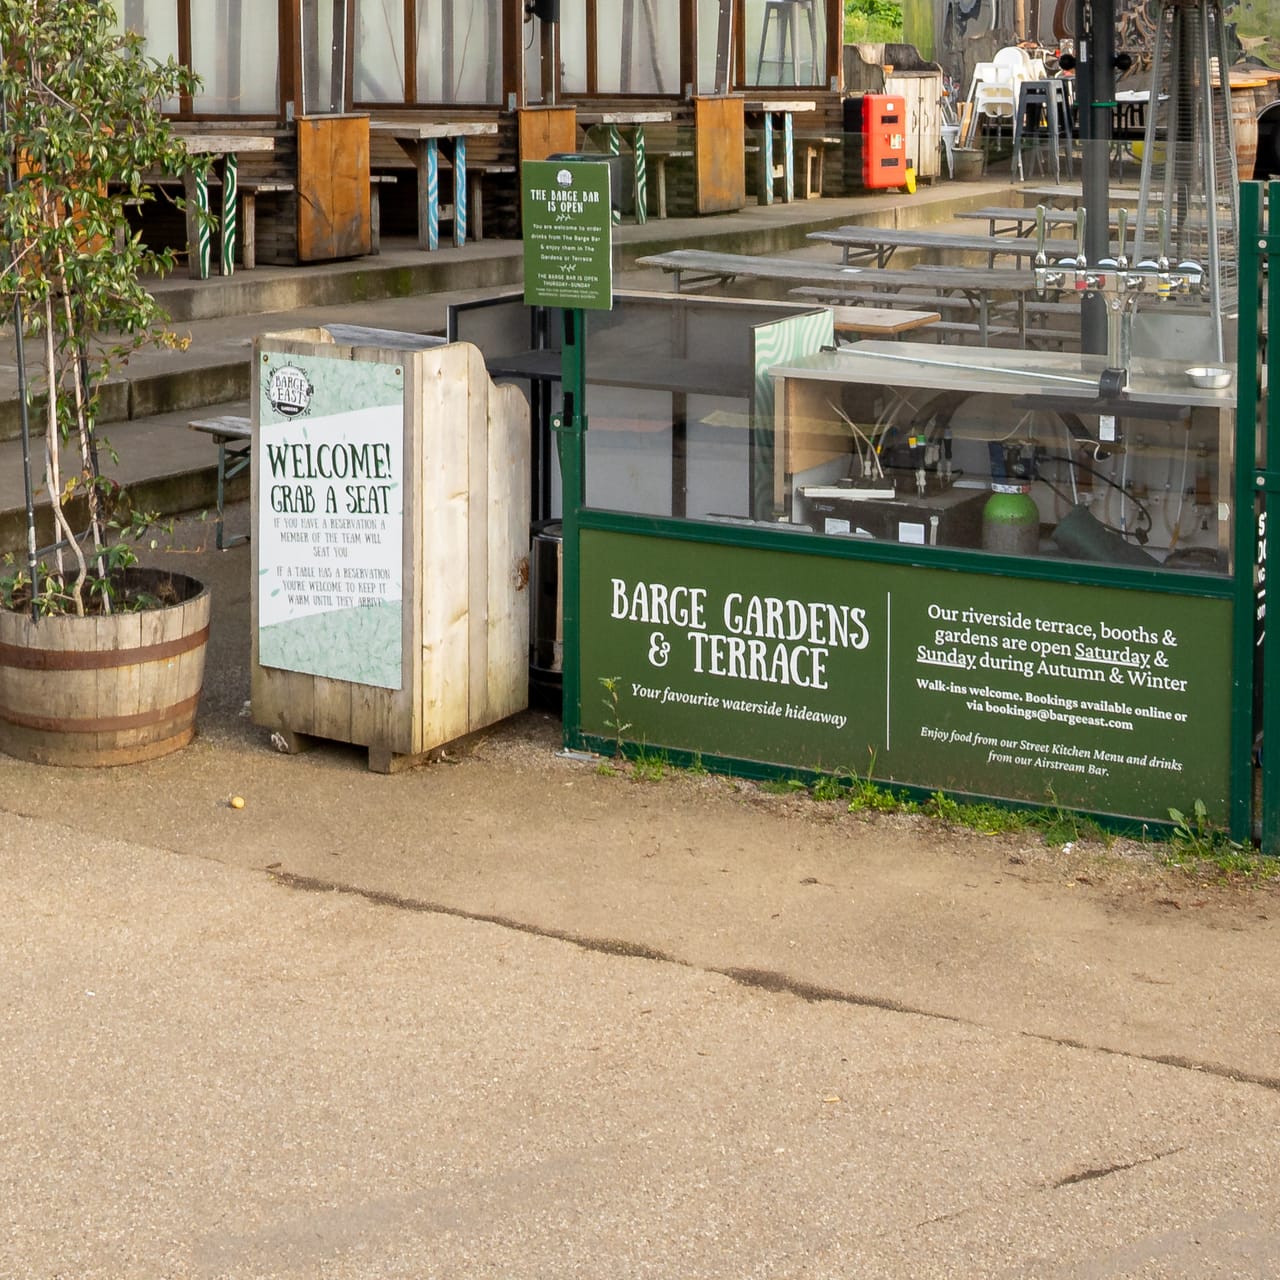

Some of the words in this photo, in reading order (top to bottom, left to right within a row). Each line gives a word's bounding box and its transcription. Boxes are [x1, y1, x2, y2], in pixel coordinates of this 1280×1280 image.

[530, 189, 546, 200] THE
[551, 190, 577, 201] BARGE
[583, 192, 599, 202] BAR
[548, 201, 556, 212] IS
[561, 202, 583, 213] OPEN
[276, 376, 305, 392] BARGE
[278, 389, 304, 404] EAST
[266, 443, 392, 478] WELCOME!
[271, 485, 315, 513] GRAB
[325, 485, 337, 513] A
[346, 485, 391, 514] SEAT
[274, 518, 280, 528] IF
[284, 518, 297, 528] YOU
[301, 518, 318, 529] HAVE
[322, 519, 327, 529] A
[331, 519, 376, 530] RESERVATION
[381, 520, 385, 530] A
[281, 532, 308, 543] MEMBER
[312, 533, 320, 543] OF
[325, 533, 337, 543] THE
[342, 533, 361, 544] TEAM
[365, 534, 381, 544] WILL
[313, 546, 329, 557] SEAT
[333, 547, 347, 557] YOU
[276, 566, 283, 576] IF
[288, 567, 292, 577] A
[296, 567, 315, 577] TABLE
[319, 568, 332, 578] HAS
[335, 568, 340, 578] A
[344, 568, 390, 579] RESERVATION
[288, 595, 309, 605] WARM
[313, 595, 333, 606] UNTIL
[336, 596, 354, 607] THEY
[309, 581, 341, 592] WELCOME
[346, 582, 355, 592] TO
[359, 583, 375, 593] KEEP
[379, 583, 385, 593] IT
[611, 579, 707, 630] BARGE
[724, 593, 870, 650] GARDENS
[928, 604, 959, 622] Our
[962, 608, 1031, 629] riverside
[1035, 617, 1097, 640] terrace,
[1100, 622, 1157, 644] booths
[1162, 630, 1177, 647] &
[649, 632, 670, 667] &
[688, 632, 828, 690] TERRACE
[934, 628, 998, 647] gardens
[1002, 638, 1027, 651] are
[1031, 640, 1071, 658] open
[1075, 643, 1150, 669] Saturday
[1154, 651, 1169, 667] &
[917, 646, 976, 669] Sunday
[979, 650, 1033, 677] during
[1036, 660, 1105, 682] Autumn
[1109, 667, 1124, 684] &
[1127, 670, 1187, 691] Winter
[632, 684, 661, 700] Your
[661, 687, 719, 708] favourite
[722, 699, 782, 717] waterside
[785, 704, 847, 730] hideaway
[916, 678, 967, 694] Walk-ins
[969, 685, 1023, 701] welcome.
[1026, 692, 1078, 710] Bookings
[1080, 699, 1132, 715] available
[1134, 706, 1172, 720] online
[1174, 712, 1187, 722] or
[966, 701, 983, 712] via
[985, 701, 1133, 730] bookings@bargeeast.com
[920, 726, 948, 742] Enjoy
[950, 729, 972, 744] food
[972, 734, 997, 747] from
[1000, 738, 1018, 749] our
[1020, 740, 1049, 753] Street
[1051, 743, 1091, 759] Kitchen
[1093, 749, 1124, 763] Menu
[1126, 755, 1148, 766] and
[1149, 757, 1182, 771] drinks
[987, 750, 1012, 764] from
[1015, 757, 1032, 767] our
[1033, 757, 1085, 774] Airstream
[1088, 764, 1109, 777] Bar.
